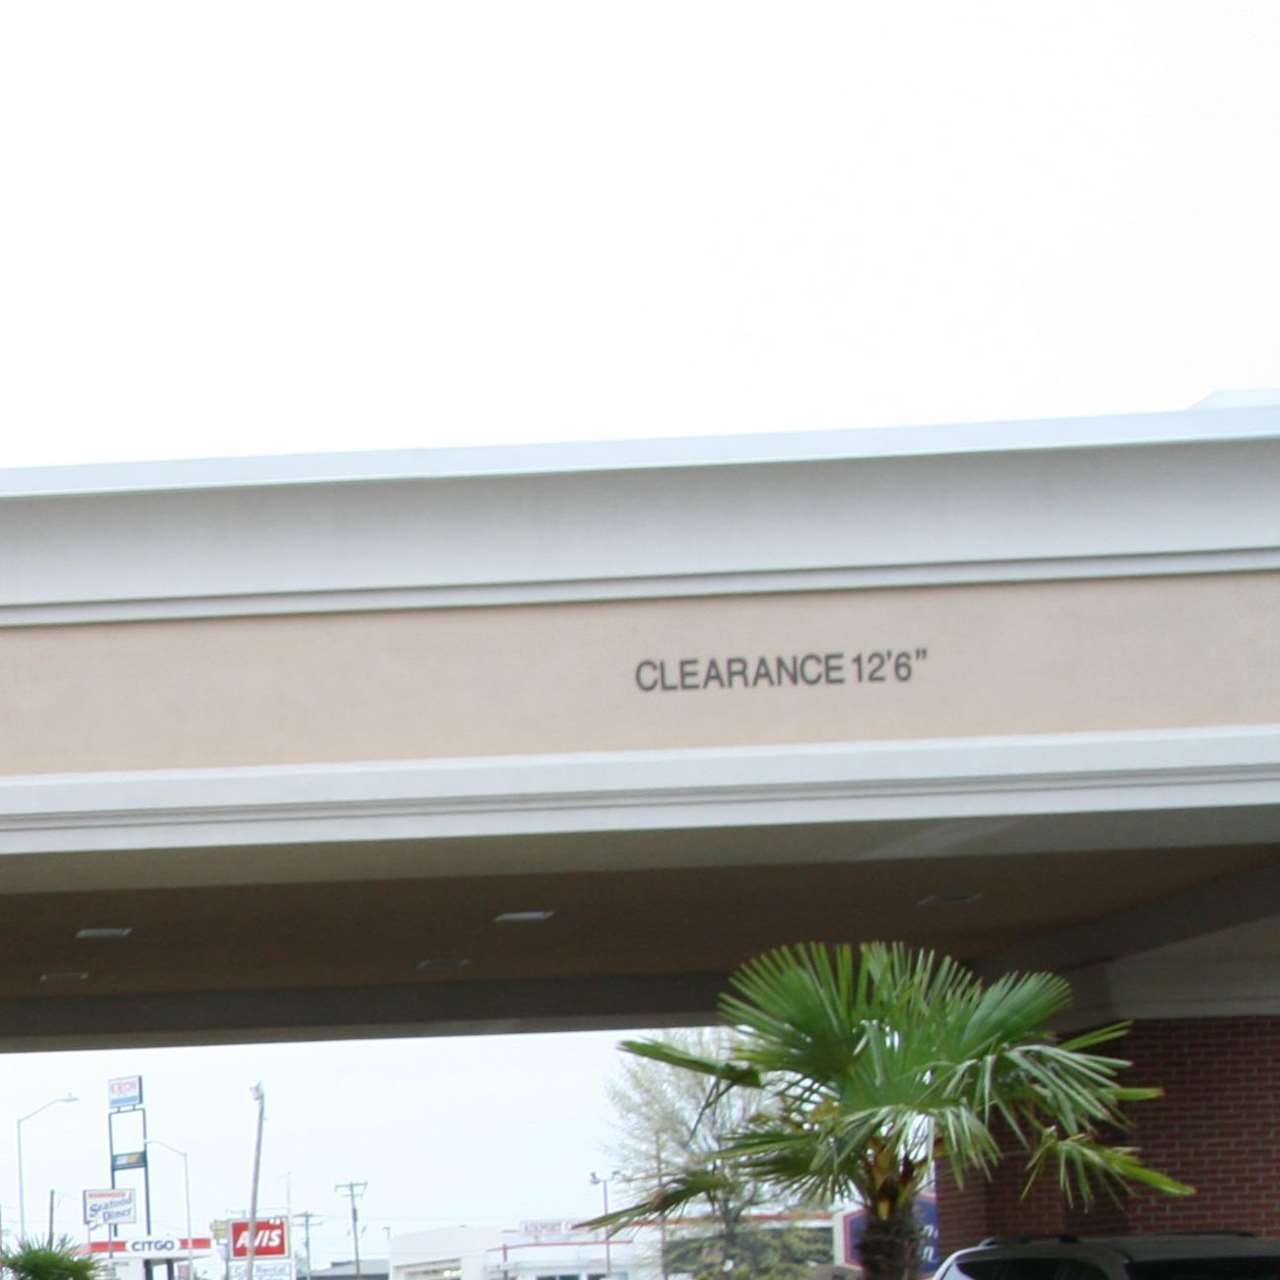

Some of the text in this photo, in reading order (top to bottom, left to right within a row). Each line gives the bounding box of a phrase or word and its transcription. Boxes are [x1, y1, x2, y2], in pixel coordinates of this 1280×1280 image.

[635, 648, 928, 692] CLEARANCE 12'6"
[131, 1240, 175, 1252] CITGO
[236, 1229, 282, 1249] AVIS
